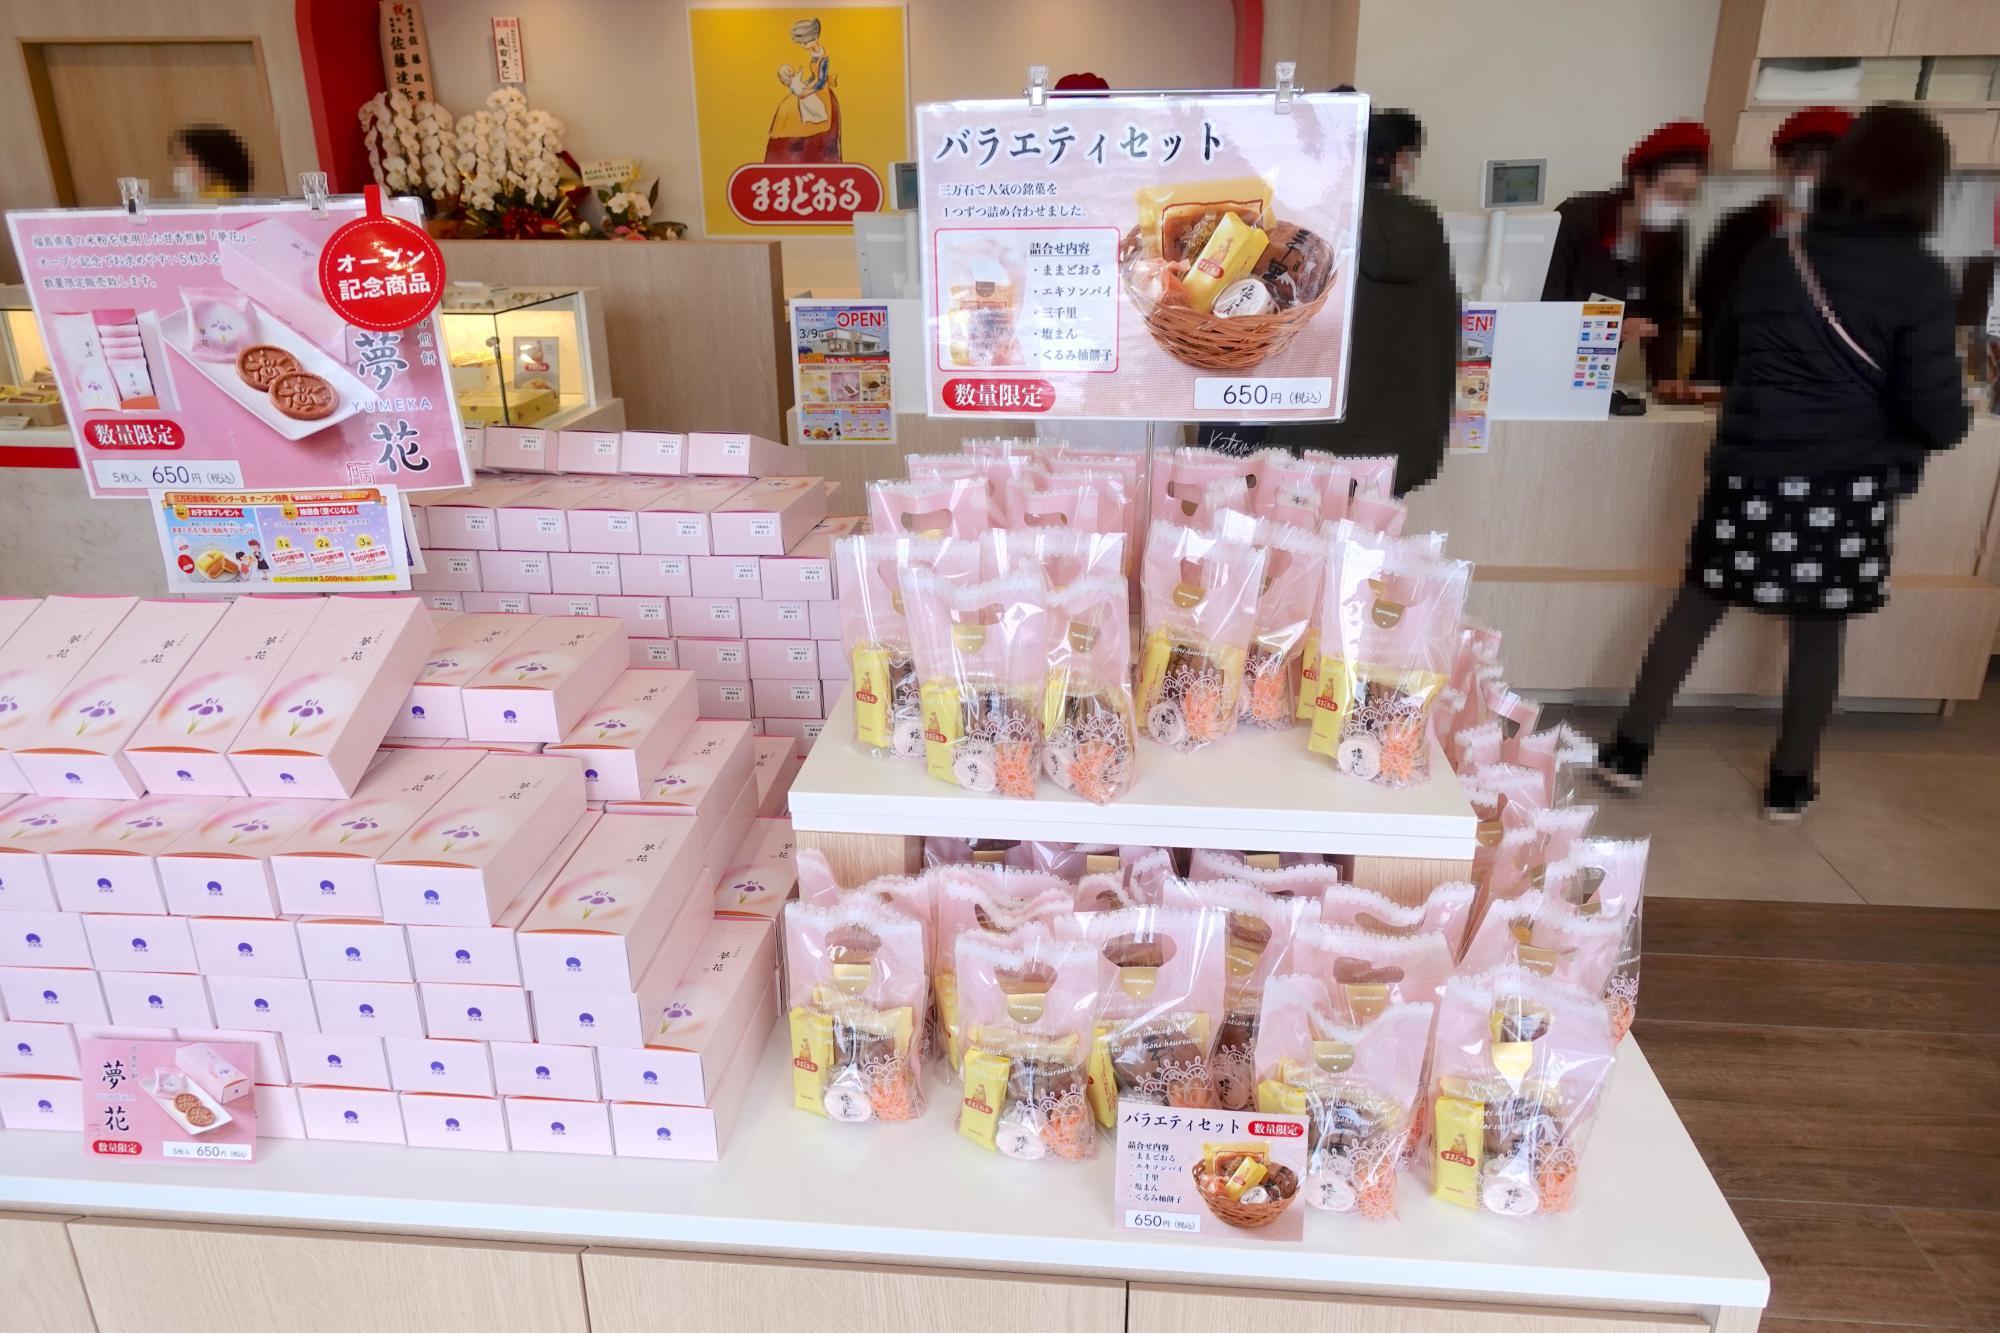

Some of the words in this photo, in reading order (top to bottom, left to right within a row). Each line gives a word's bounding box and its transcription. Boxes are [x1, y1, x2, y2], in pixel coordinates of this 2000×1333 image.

[936, 121, 1225, 165] バラエティセット
[751, 176, 861, 217] ままどおる
[940, 182, 1058, 197] 三万石で人気の銘菓を
[944, 205, 1088, 219] 1つずつ詰め合わせました。
[1029, 242, 1091, 256] 詰合せ内容
[337, 248, 426, 274] オープン
[1042, 263, 1101, 276] ままどおる
[43, 276, 157, 289] 数量限定販売致します。
[338, 272, 432, 302] 記念商品
[1042, 286, 1112, 297] エキソンパイ
[836, 312, 886, 327] OPEN!
[1042, 306, 1077, 319] 三千里
[1041, 328, 1078, 340] 塩まん
[1042, 349, 1113, 362] くるみ柚餅子
[954, 383, 1045, 409] 数量限定
[1223, 383, 1282, 406] 650円
[351, 398, 432, 412] YUMEKA
[95, 423, 176, 446] 数量限定
[112, 472, 142, 484] 5枚入
[152, 466, 202, 484] 650円
[1124, 1111, 1240, 1135] バラエティセット
[1253, 1122, 1299, 1137] 数量限定
[98, 1142, 138, 1154] 数量限定
[196, 1146, 227, 1158] 650円
[1127, 1141, 1170, 1152] 詰合せ内容
[1134, 1214, 1171, 1228] 650円
